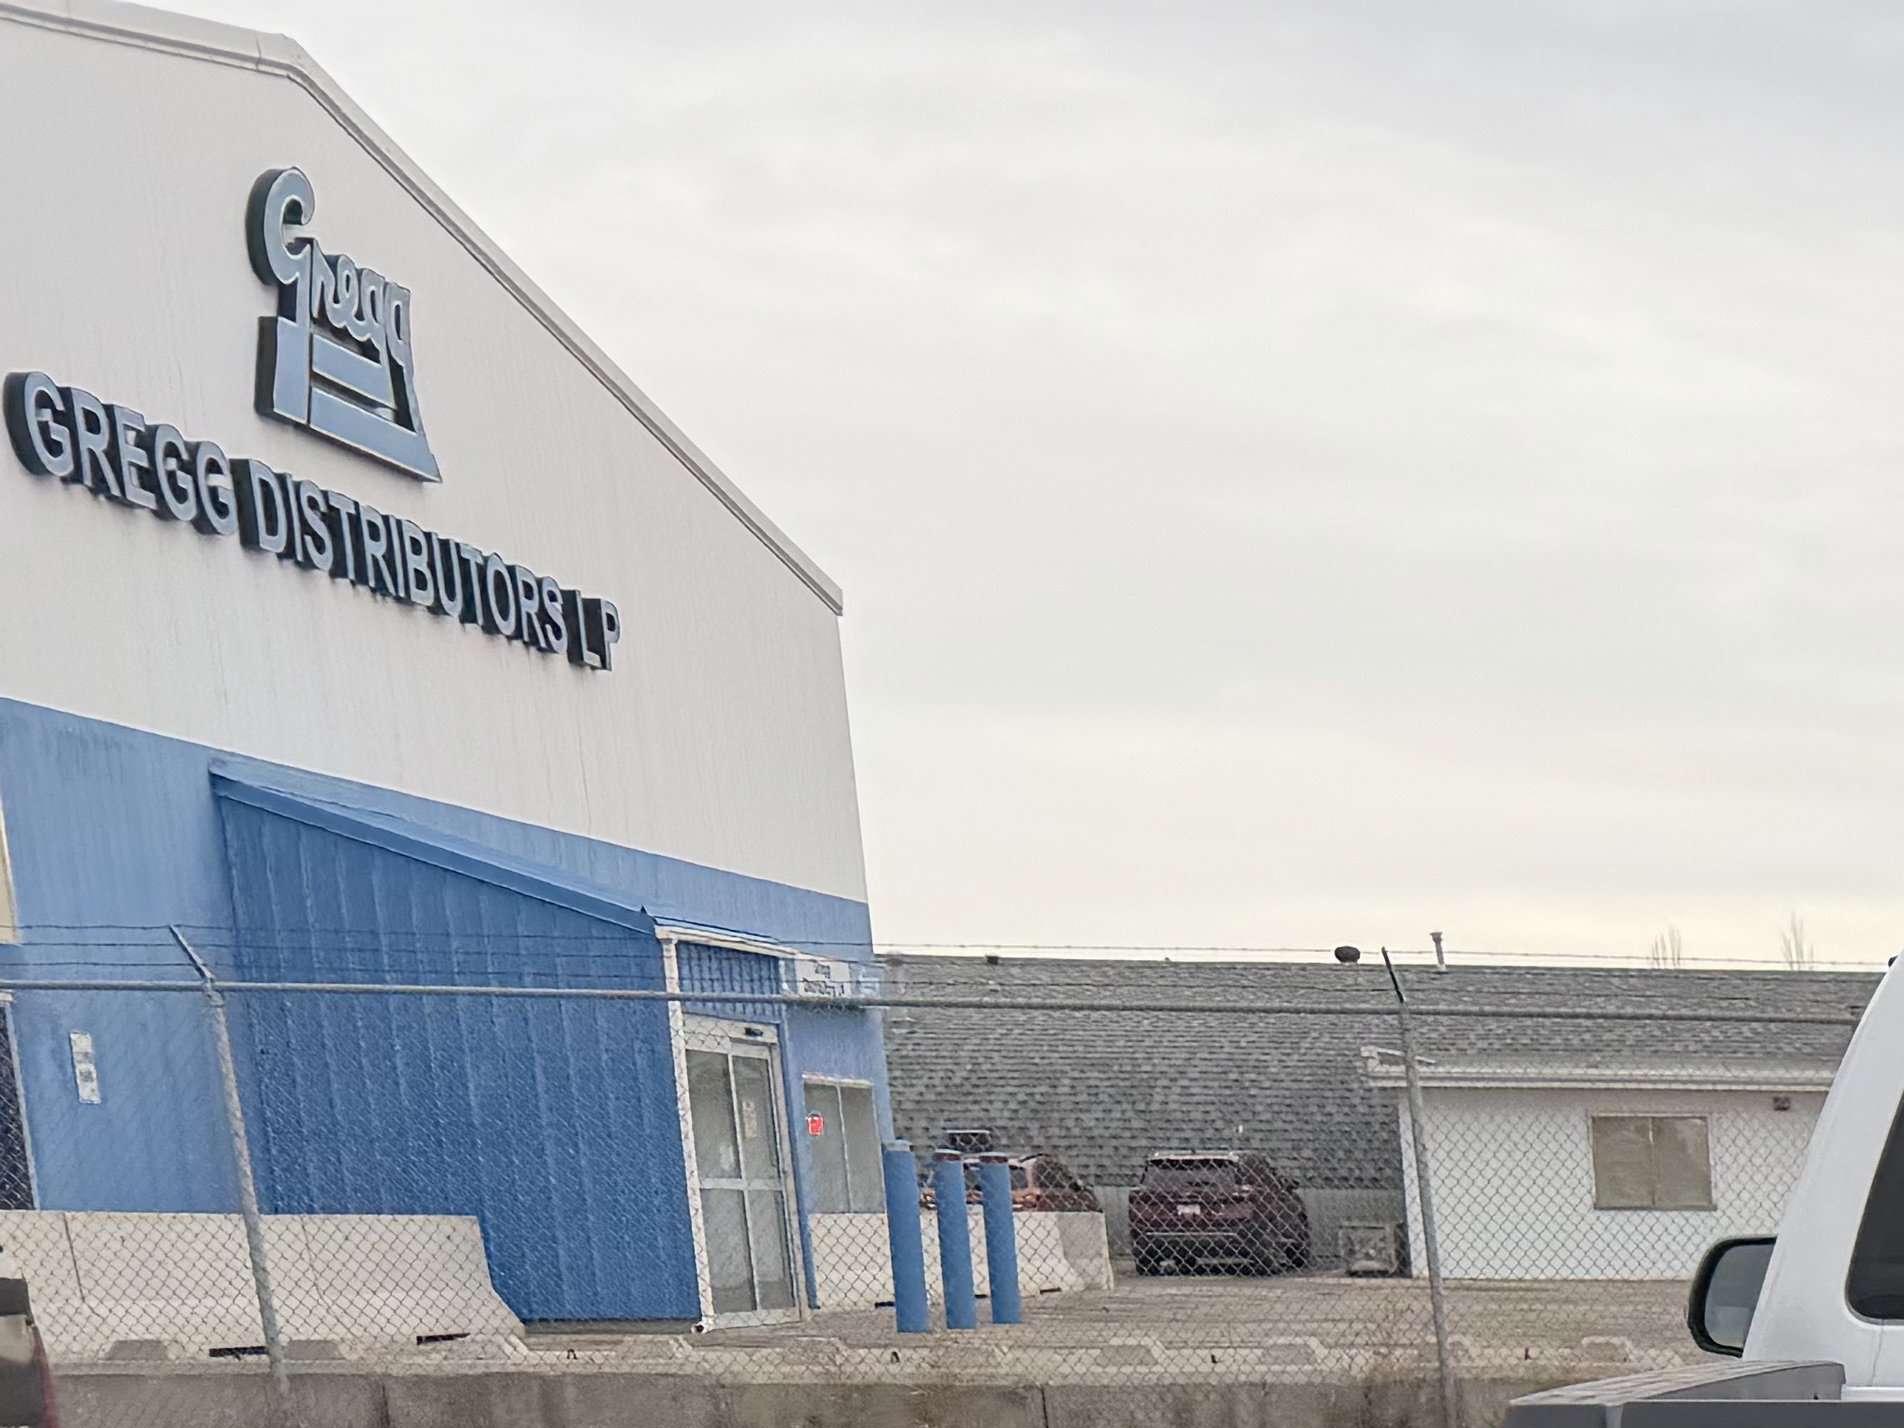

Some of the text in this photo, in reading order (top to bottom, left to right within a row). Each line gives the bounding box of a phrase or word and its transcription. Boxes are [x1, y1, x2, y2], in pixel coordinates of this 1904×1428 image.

[248, 167, 442, 482] Gregg
[4, 372, 621, 671] GREGG DISTRIBUTORS LP
